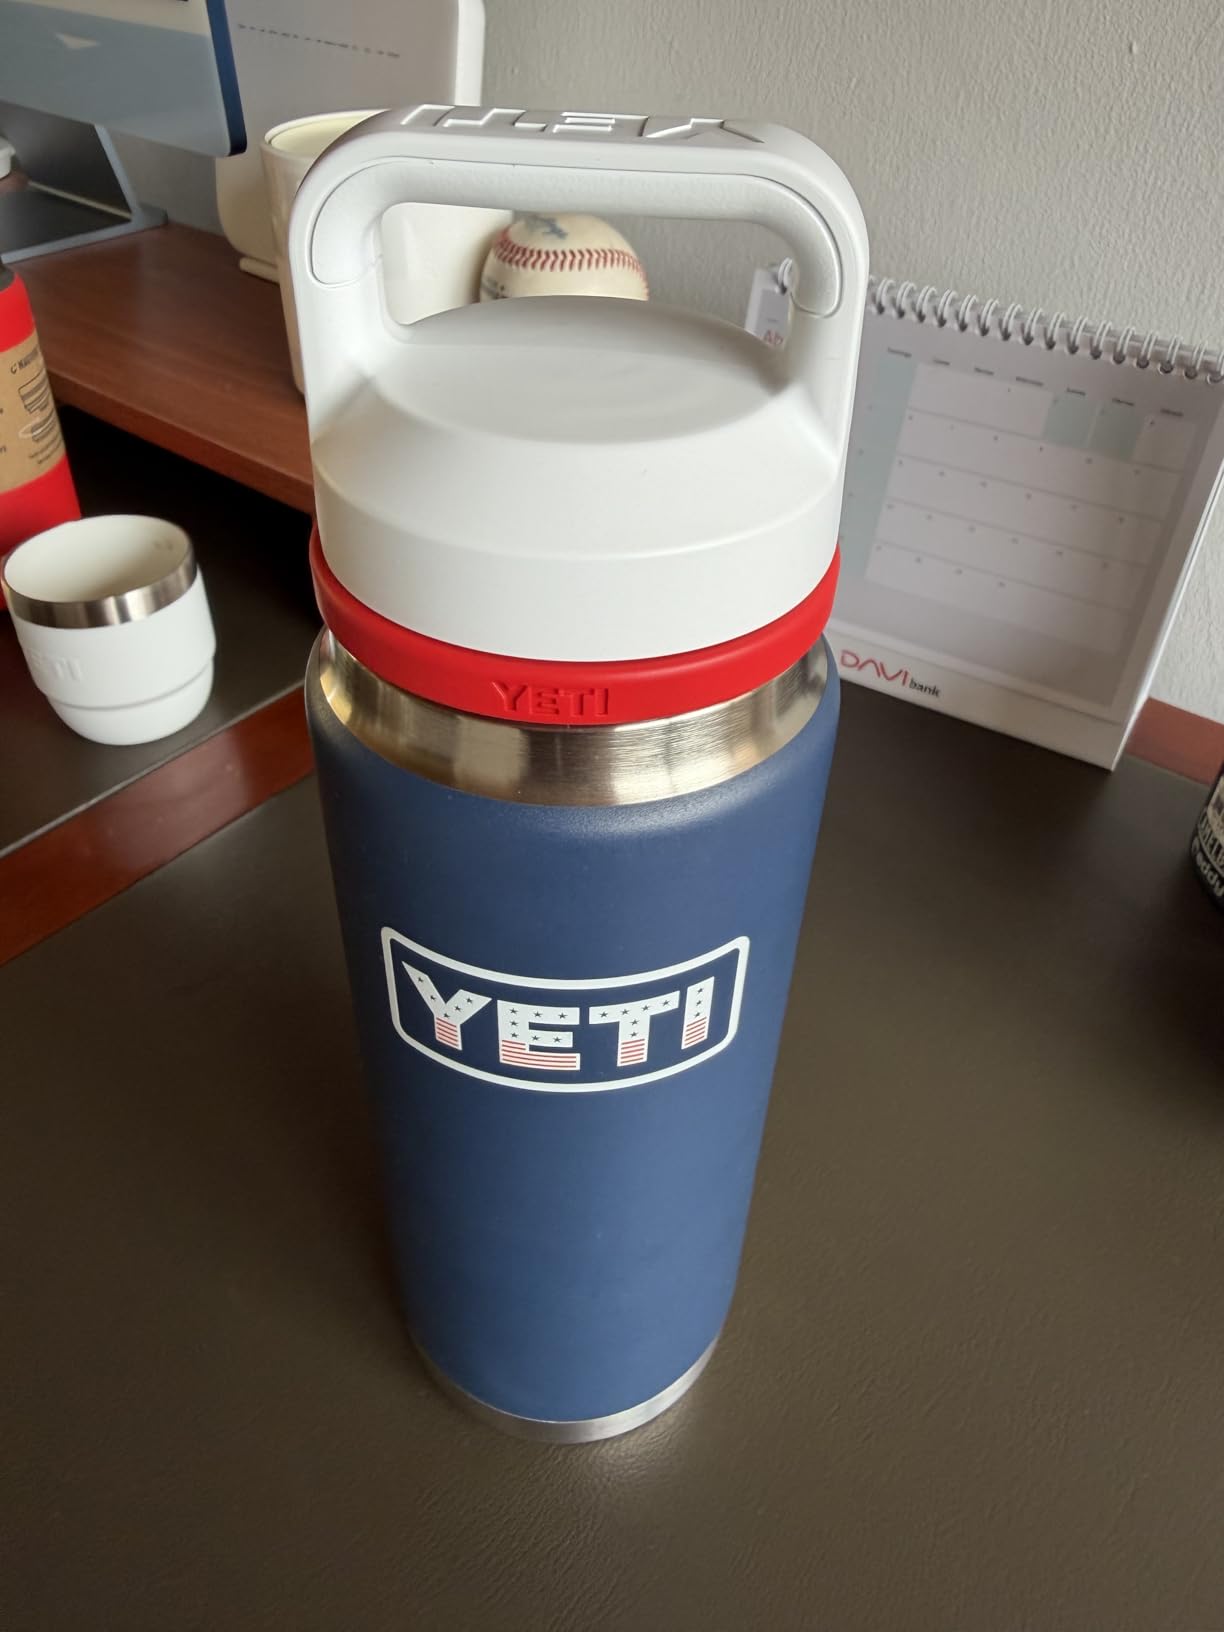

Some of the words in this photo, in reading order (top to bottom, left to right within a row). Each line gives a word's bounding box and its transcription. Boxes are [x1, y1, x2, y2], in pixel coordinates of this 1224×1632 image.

[840, 649, 909, 686] DAVI
[908, 677, 941, 698] bank
[491, 680, 609, 718] YETI
[401, 960, 715, 1071] YETI
